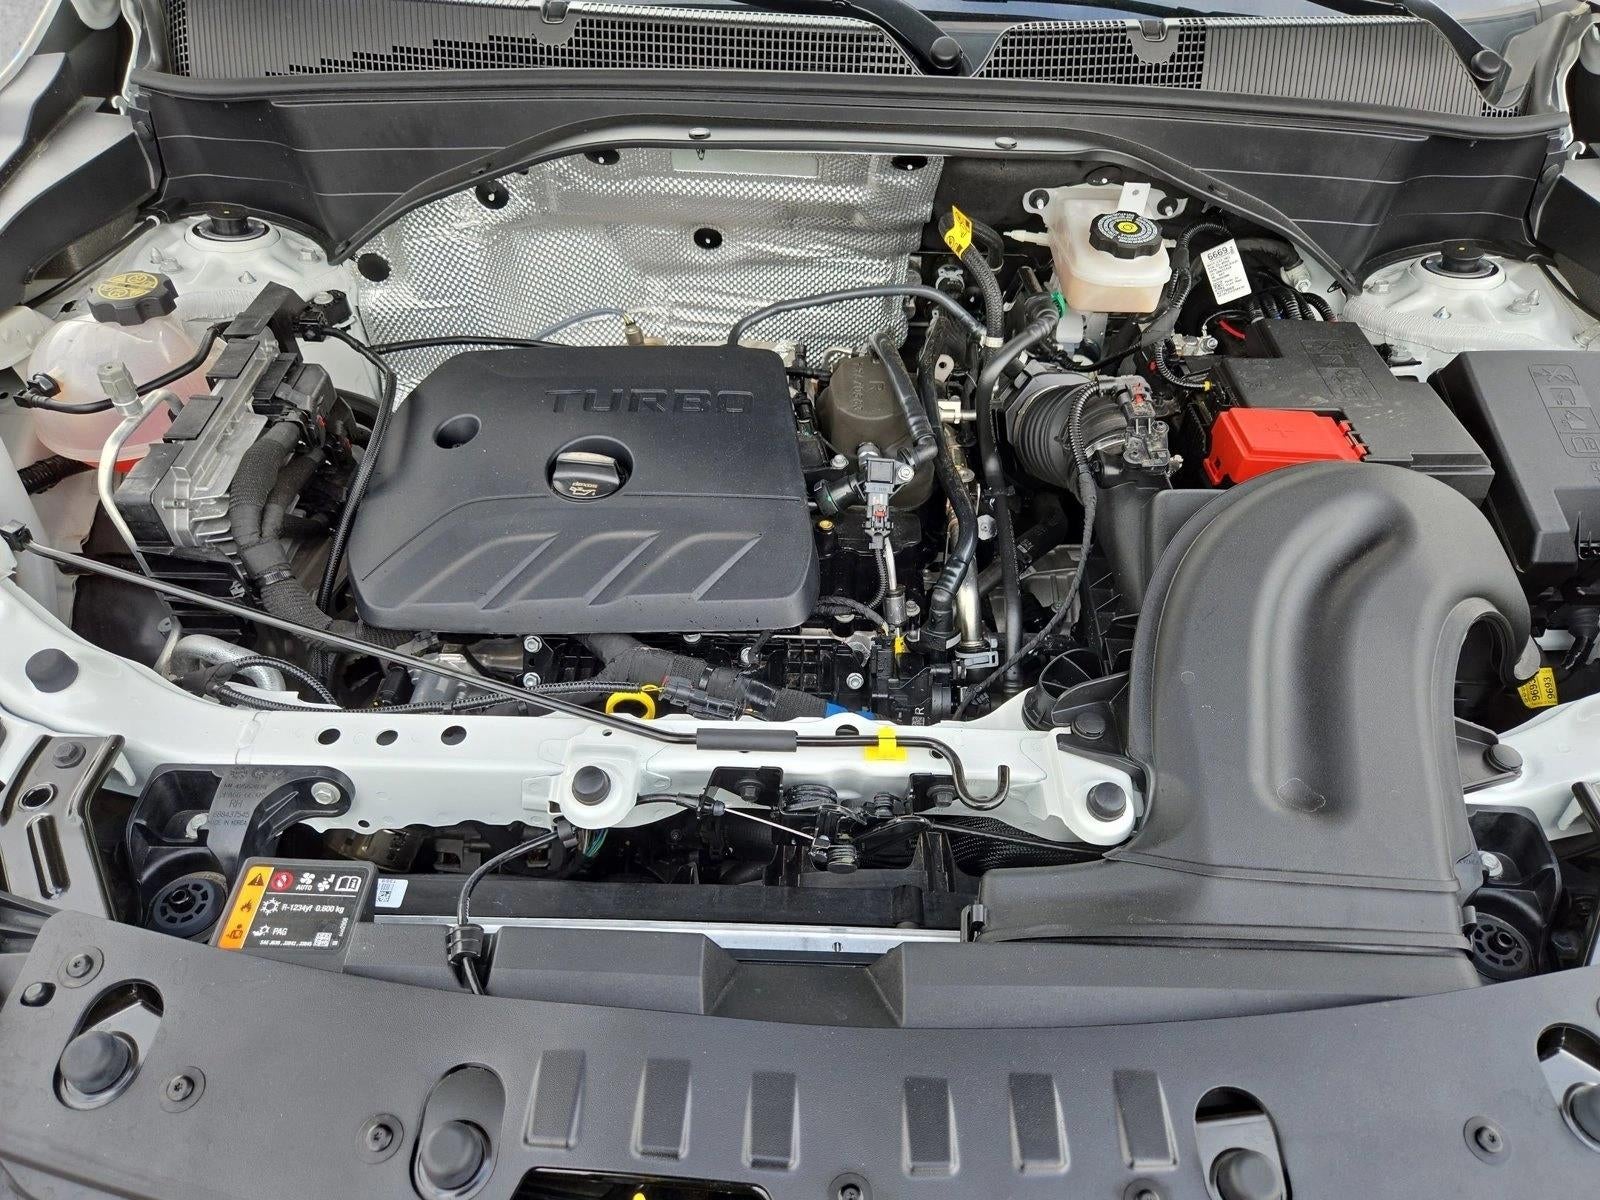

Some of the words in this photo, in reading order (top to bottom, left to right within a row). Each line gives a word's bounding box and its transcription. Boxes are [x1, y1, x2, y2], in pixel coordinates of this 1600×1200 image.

[1207, 246, 1228, 261] 6669
[545, 388, 754, 413] TURBO
[1544, 676, 1555, 700] 9693
[281, 903, 313, 913] R-1234yf
[335, 905, 345, 914] kg
[272, 927, 288, 935] PAG
